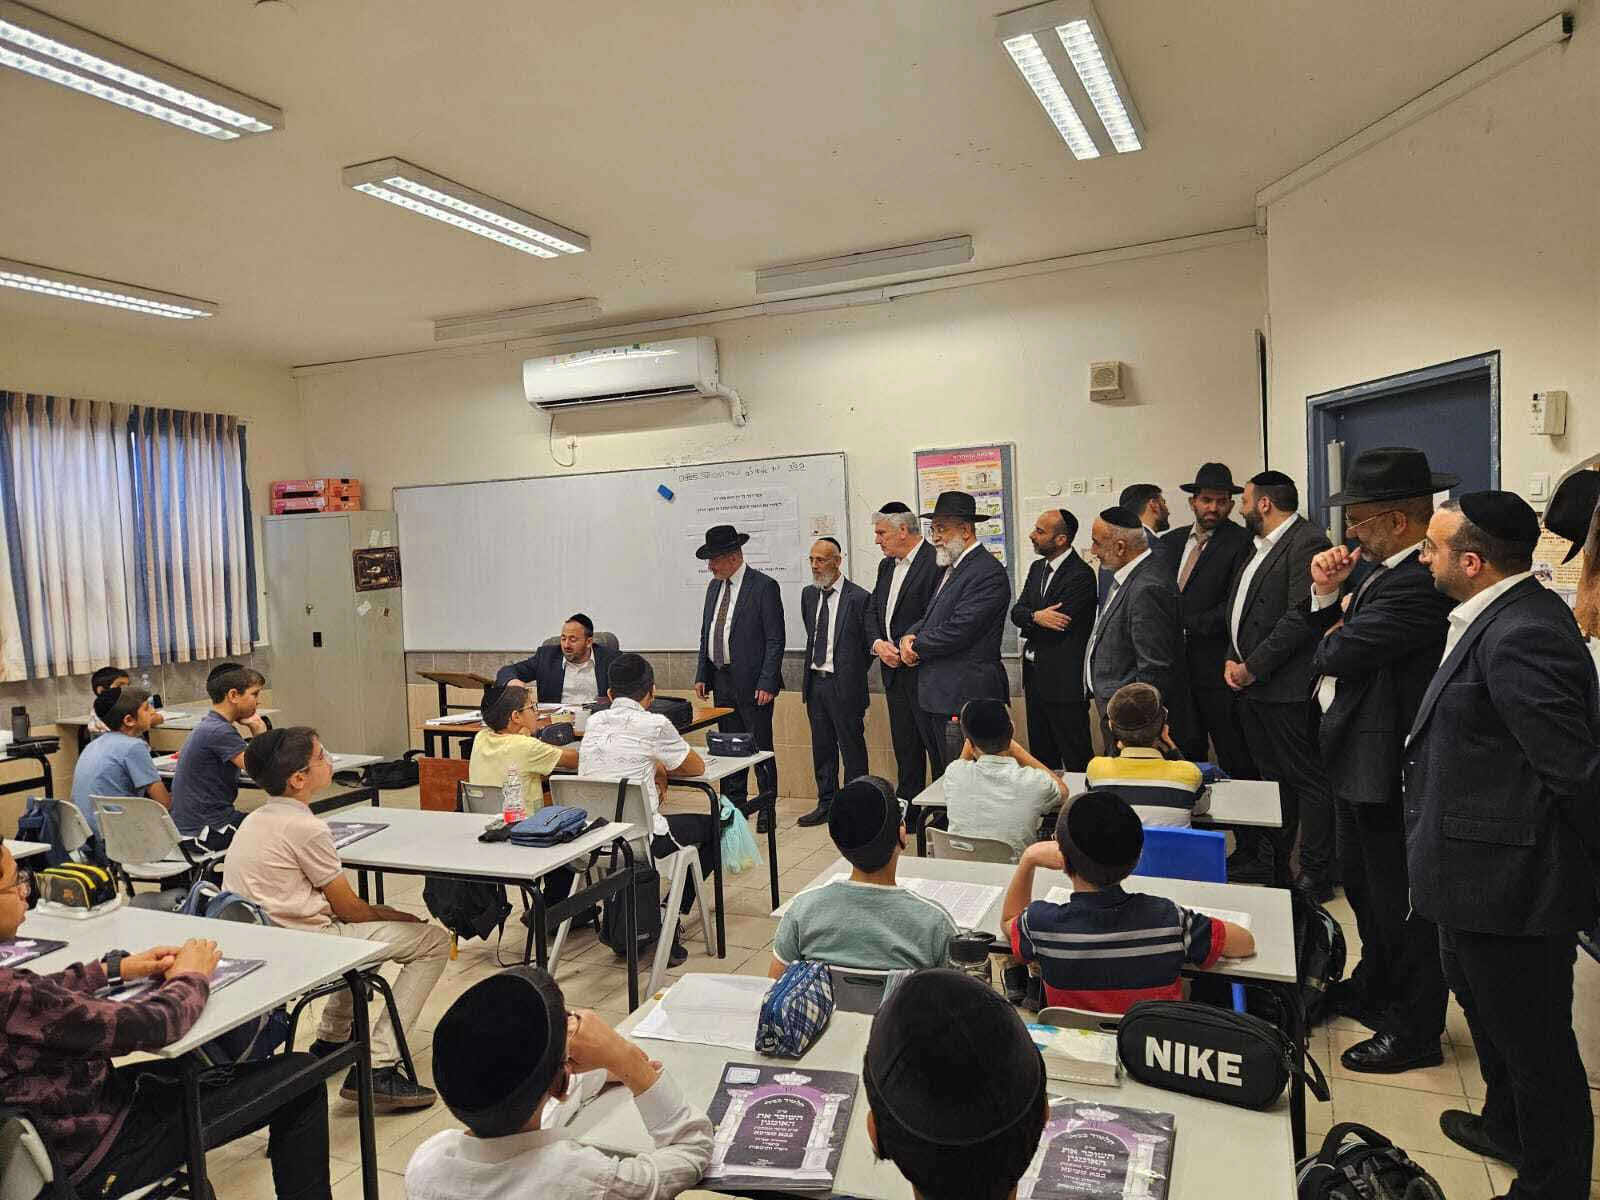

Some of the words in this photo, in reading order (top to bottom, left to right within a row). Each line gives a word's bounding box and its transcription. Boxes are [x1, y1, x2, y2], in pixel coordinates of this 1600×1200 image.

[1145, 1035, 1242, 1087] NIKE
[774, 1113, 804, 1121] השוכר
[1061, 1146, 1078, 1155] את
[1081, 1150, 1115, 1160] השוכר
